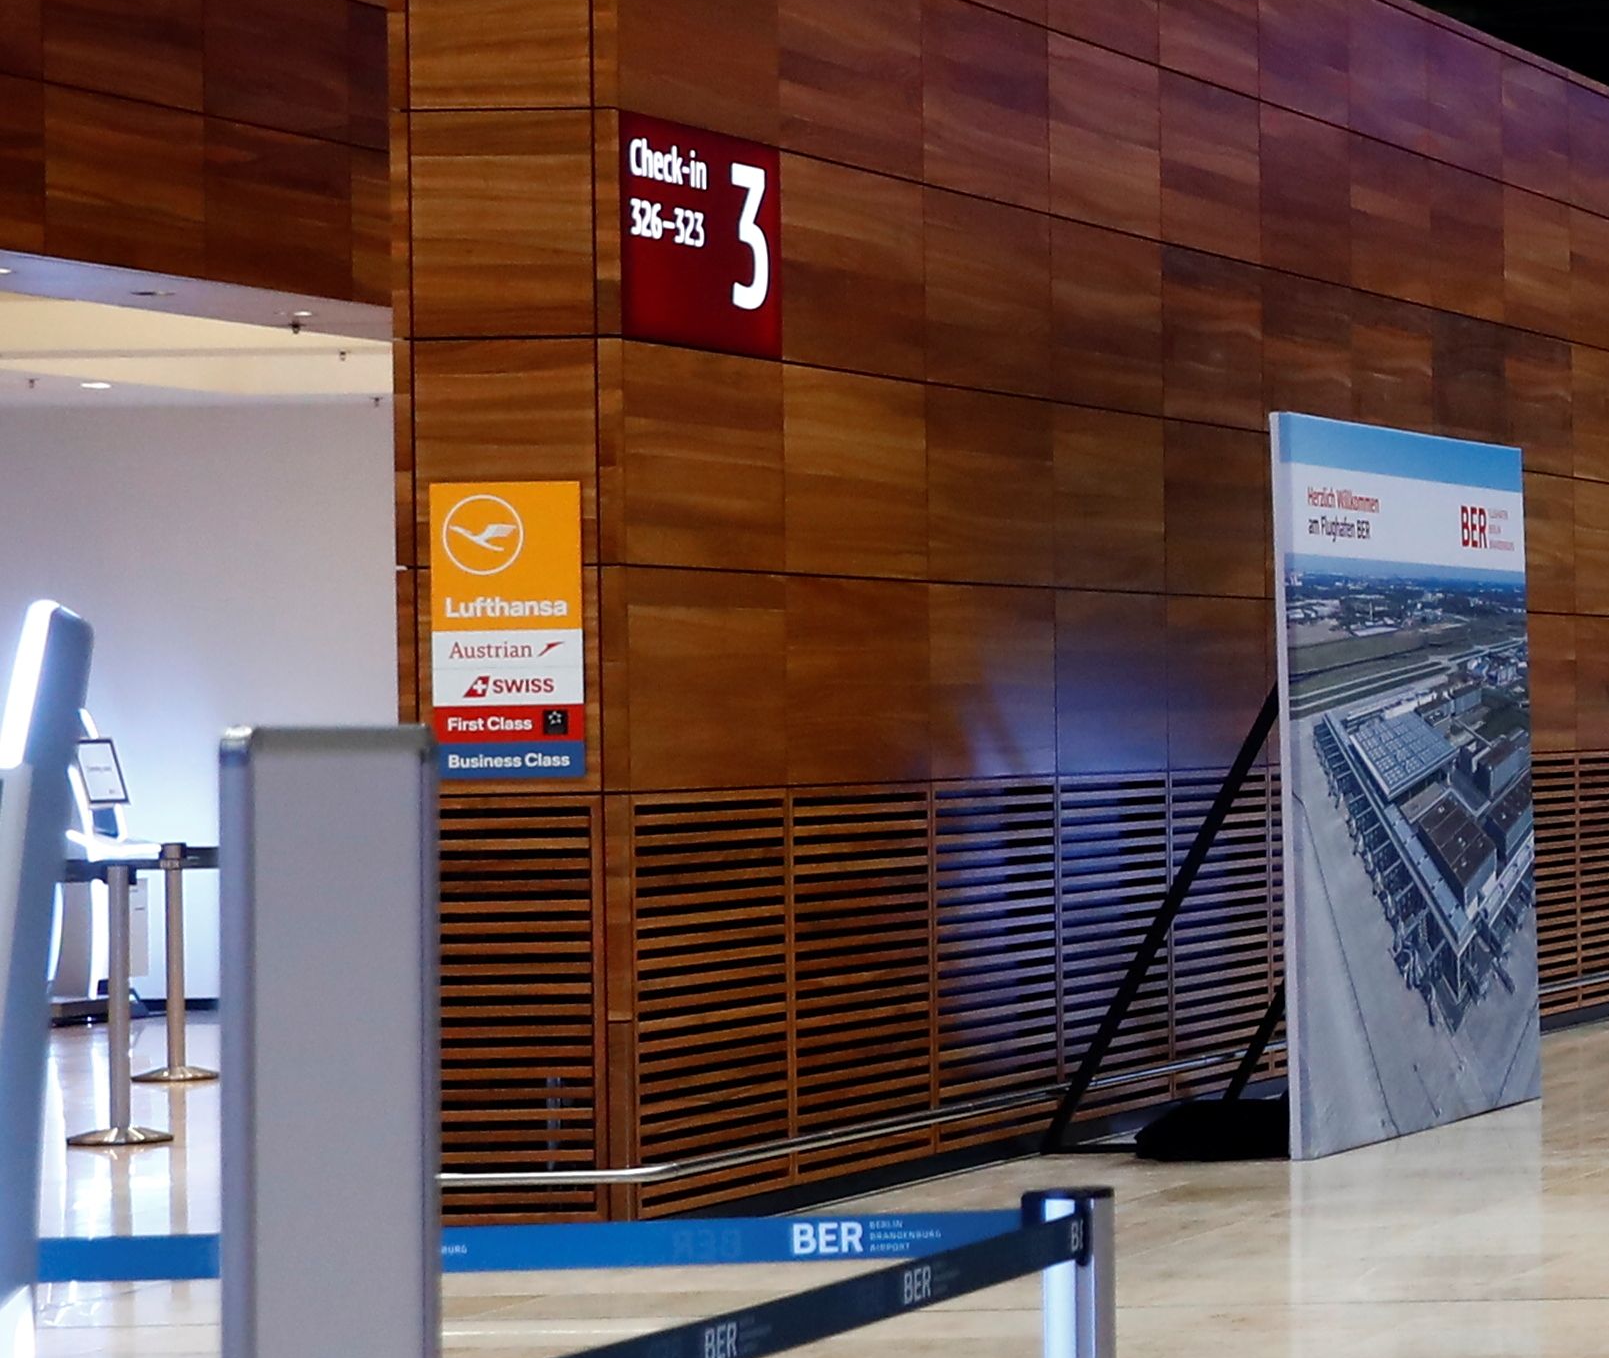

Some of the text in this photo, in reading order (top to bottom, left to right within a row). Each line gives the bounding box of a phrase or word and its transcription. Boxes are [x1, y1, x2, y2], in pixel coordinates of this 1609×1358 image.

[629, 137, 708, 190] Check-in
[730, 162, 769, 310] 3
[1461, 505, 1488, 549] BER
[444, 596, 570, 618] Lufthansa
[449, 641, 533, 659] Austrian
[492, 678, 555, 694] SWISS
[447, 716, 533, 732] First Class
[448, 752, 571, 769] Business Class
[869, 1220, 903, 1230] BERLIN
[793, 1221, 864, 1254] BER
[869, 1242, 911, 1253] AIRPORT
[903, 1266, 932, 1305] BER
